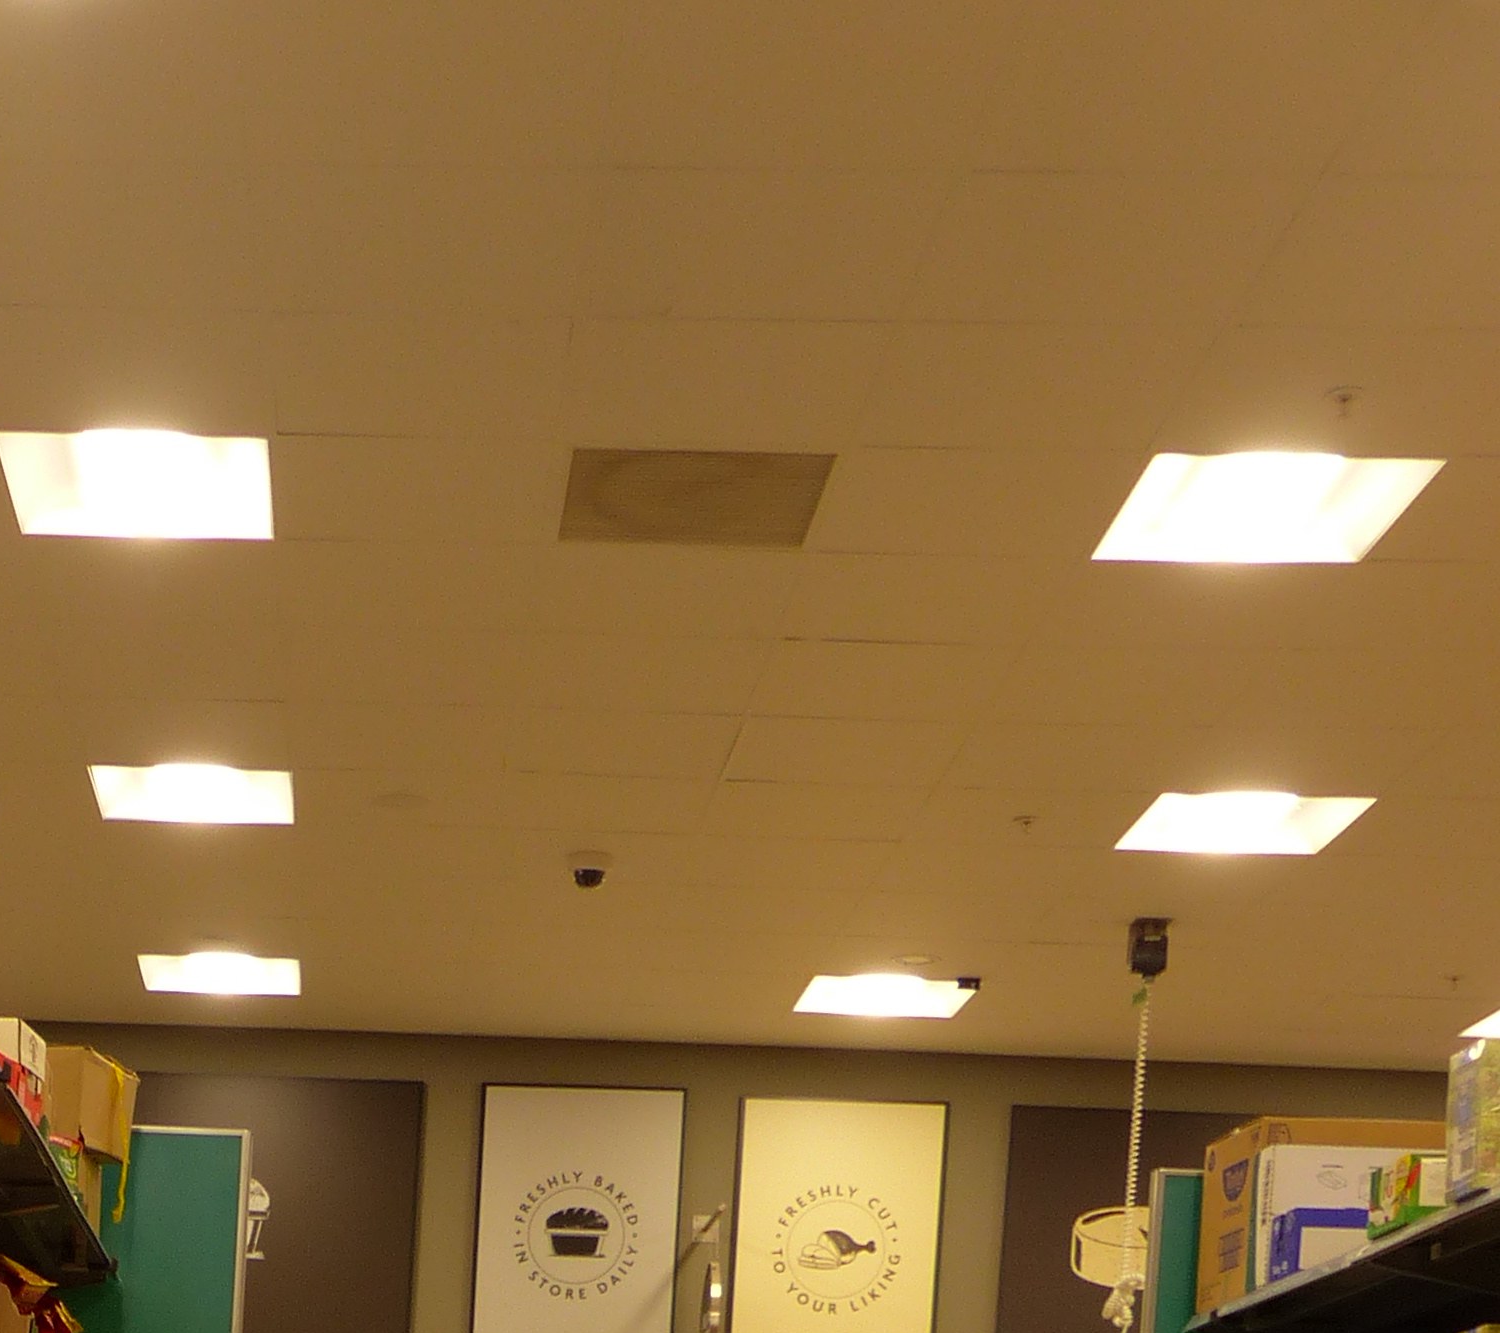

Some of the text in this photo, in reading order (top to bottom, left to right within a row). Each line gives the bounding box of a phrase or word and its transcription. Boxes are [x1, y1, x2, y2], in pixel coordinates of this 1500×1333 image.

[515, 1170, 640, 1227] FRESHLY BAKED
[777, 1184, 899, 1231] FRESHLY CUT
[514, 1241, 639, 1301] IN STORE DAILY
[772, 1247, 902, 1316] TO YOUR LIKING
